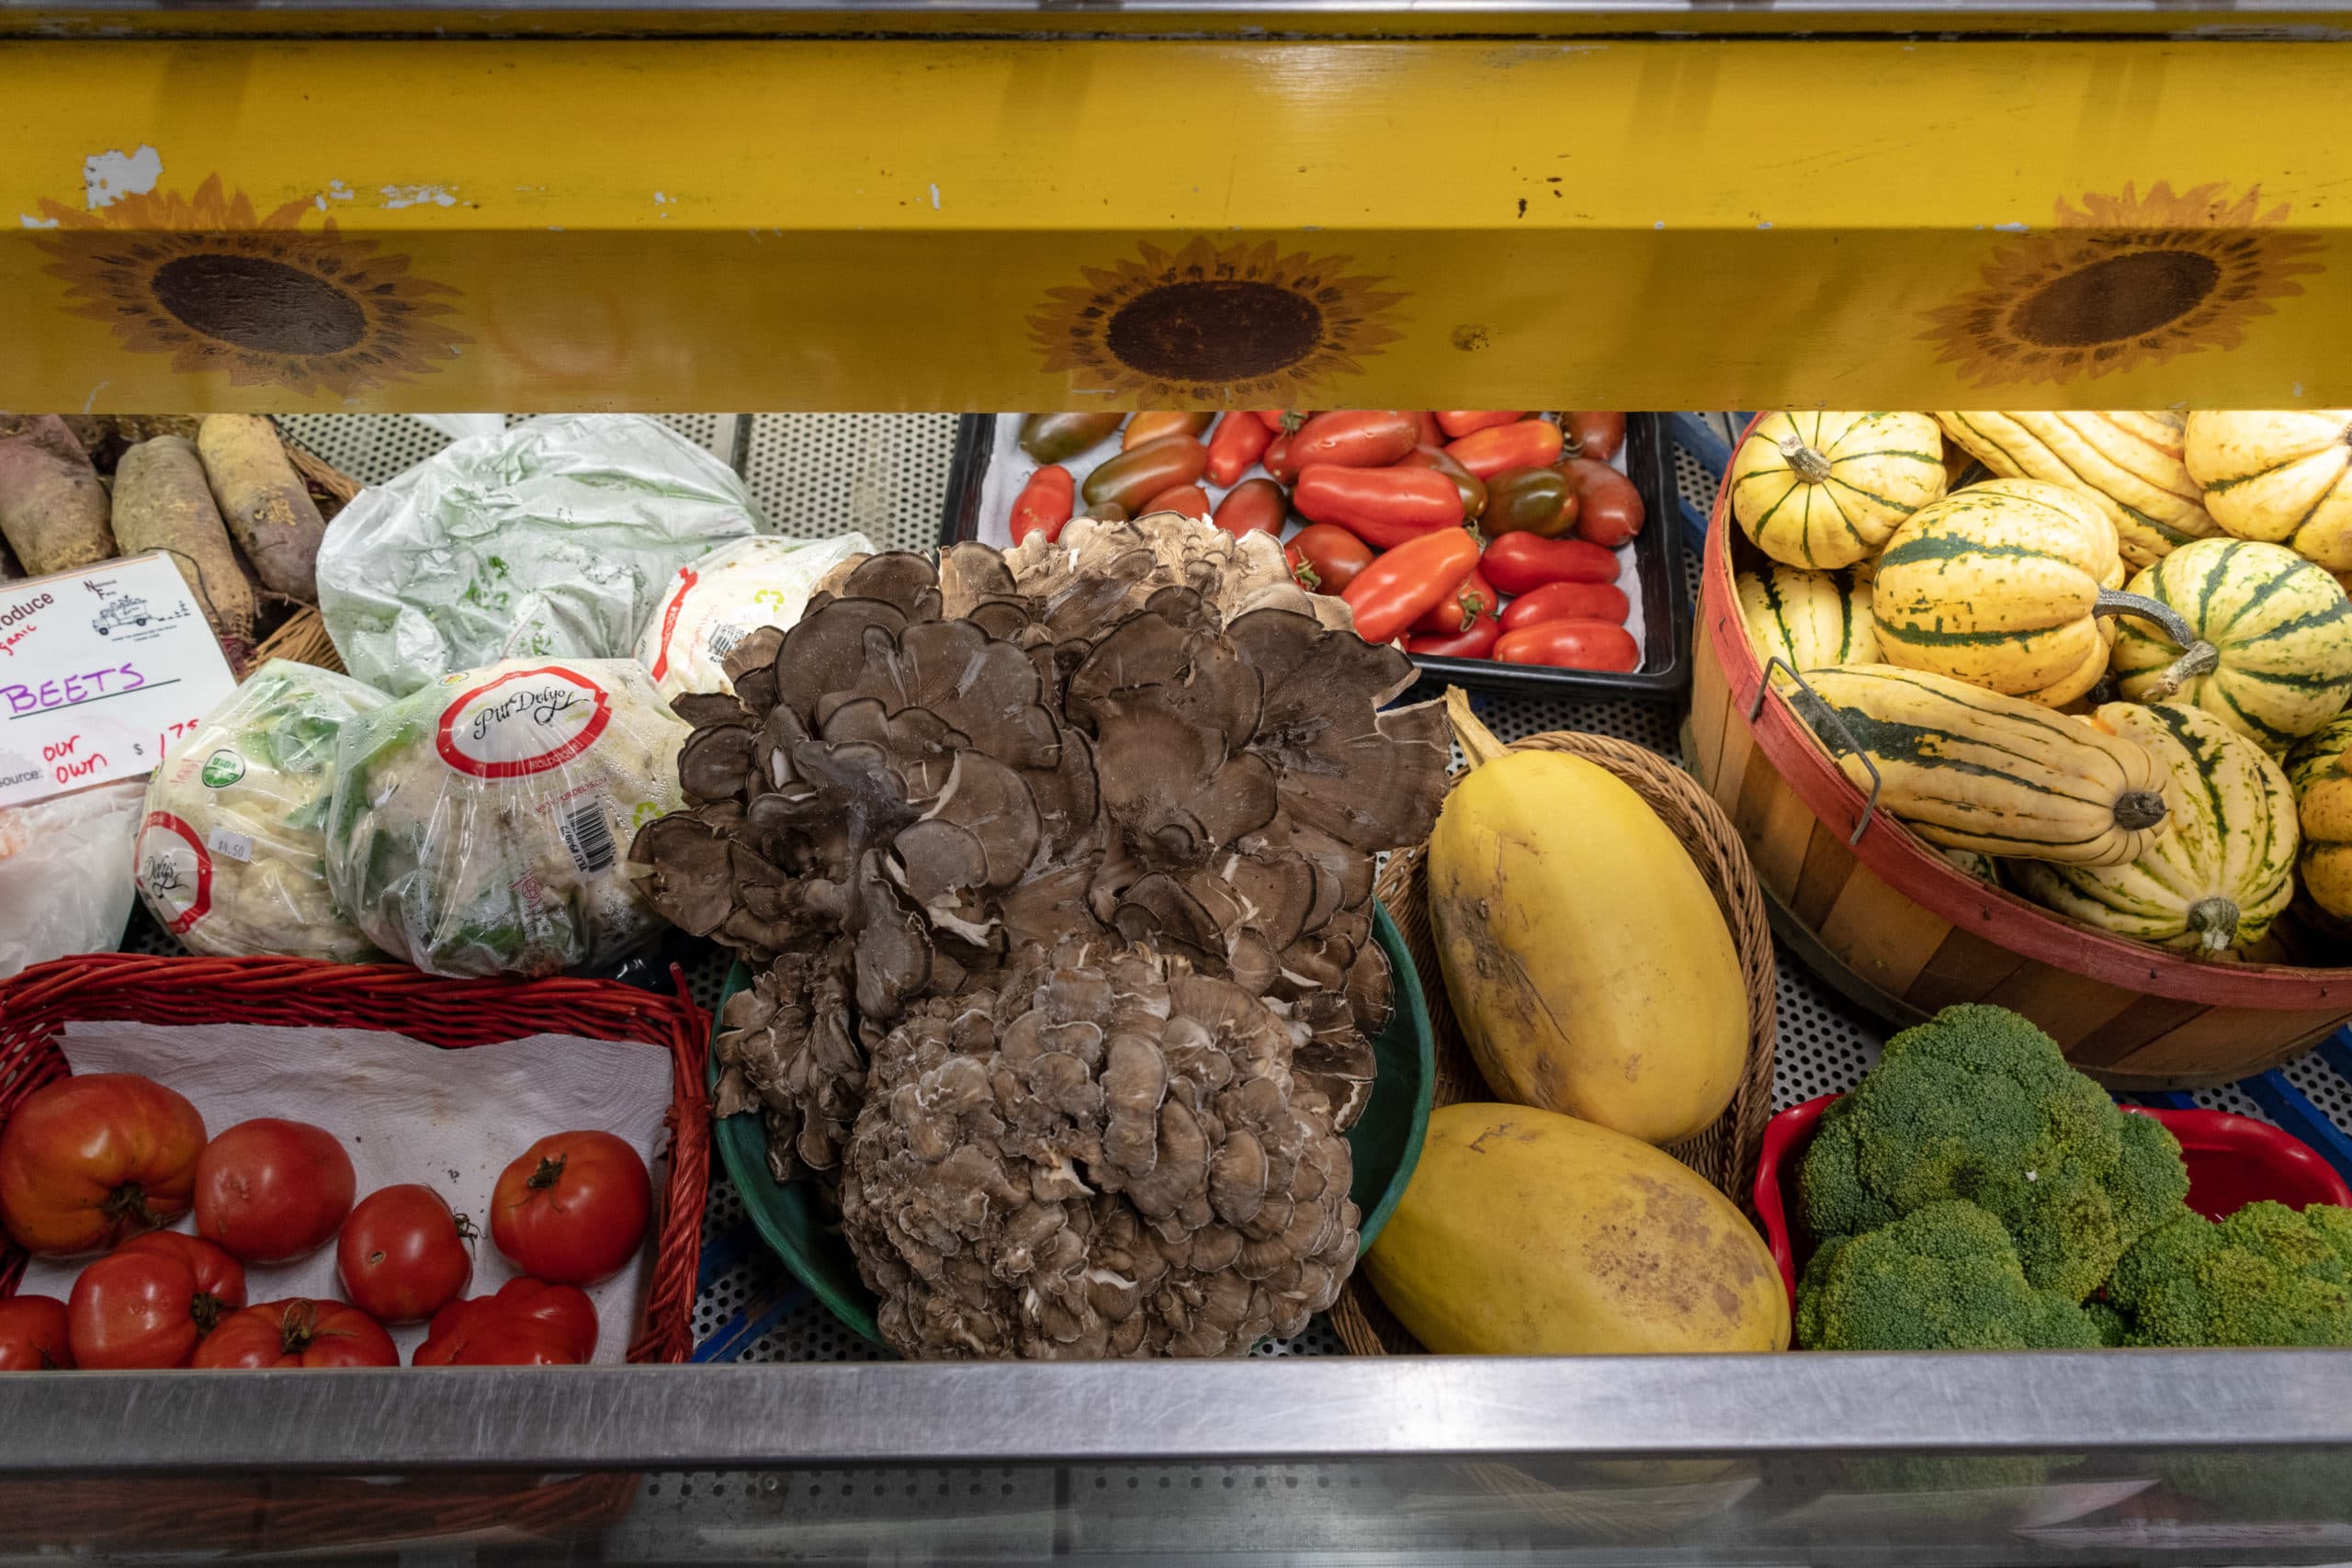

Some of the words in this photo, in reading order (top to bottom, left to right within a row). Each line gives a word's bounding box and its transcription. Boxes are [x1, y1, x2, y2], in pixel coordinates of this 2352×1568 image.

[0, 592, 54, 631] oduce
[0, 662, 145, 714] BEETS
[42, 735, 81, 762] our
[132, 742, 143, 756] $
[55, 753, 108, 784] own
[212, 757, 238, 771] USDA
